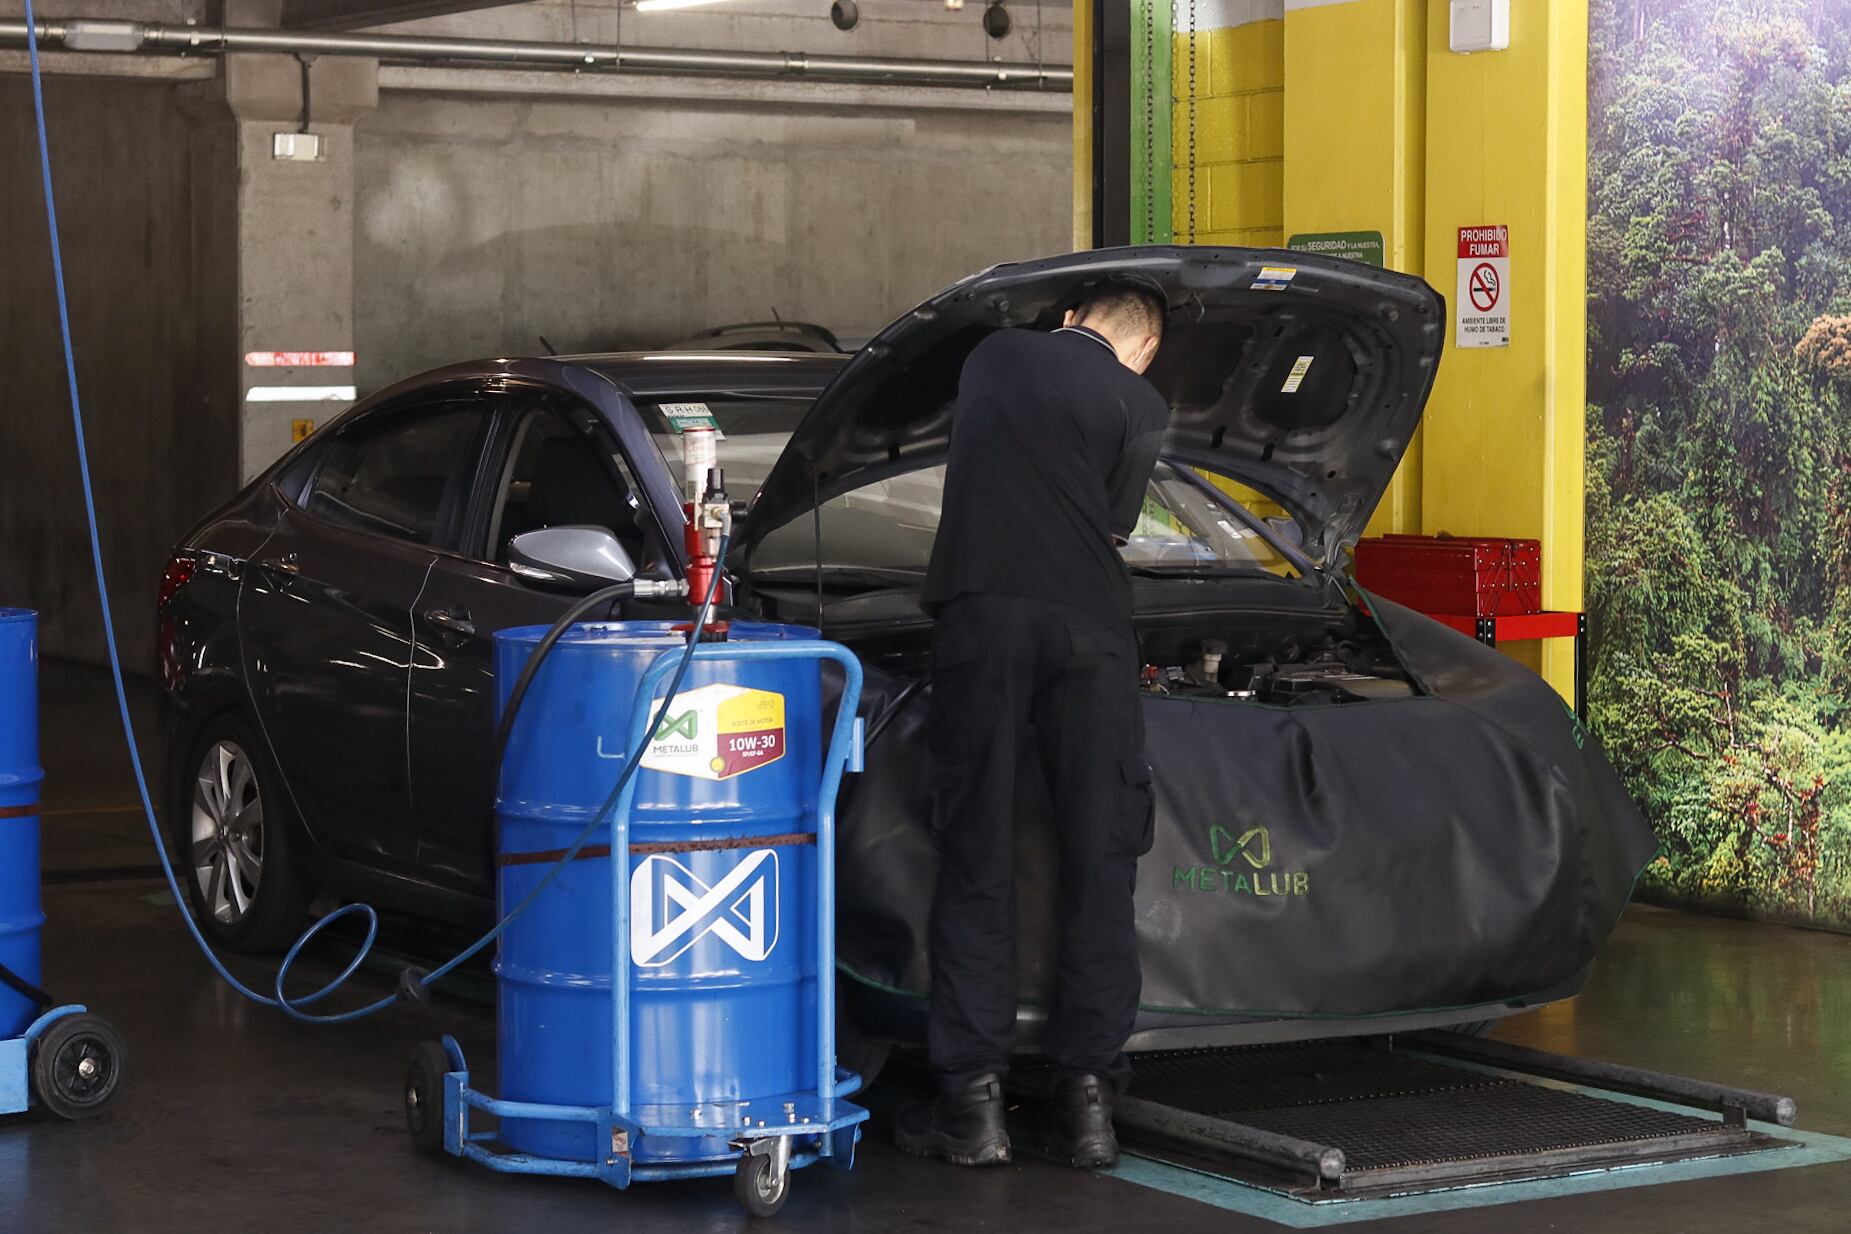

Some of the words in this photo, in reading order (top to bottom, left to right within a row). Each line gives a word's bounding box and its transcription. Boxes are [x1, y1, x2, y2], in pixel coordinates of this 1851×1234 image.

[1461, 228, 1507, 242] PROHIBIDO
[1307, 240, 1347, 251] SEGURIDAD
[1470, 243, 1500, 256] FUMAR
[1486, 325, 1505, 333] TABACO
[653, 744, 699, 754] METALUB
[729, 734, 776, 751] 10W-30
[1172, 864, 1310, 896] METALUB
